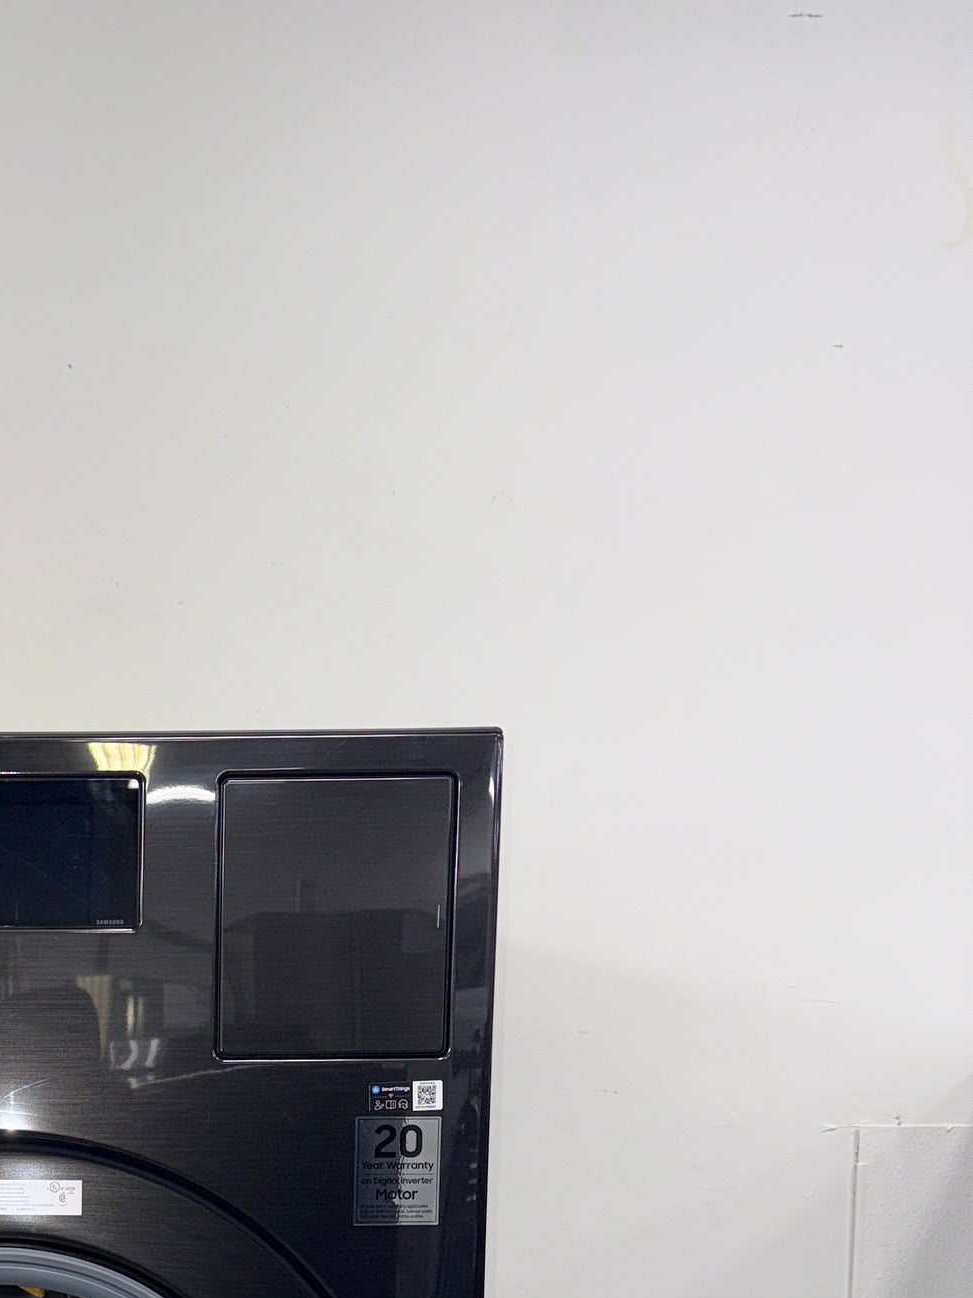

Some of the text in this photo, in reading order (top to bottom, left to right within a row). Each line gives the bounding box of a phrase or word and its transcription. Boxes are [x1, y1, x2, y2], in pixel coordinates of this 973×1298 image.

[381, 1085, 411, 1093] SmartThings
[374, 1124, 423, 1158] 20
[361, 1161, 434, 1172] Year Warranty
[374, 1177, 399, 1186] Digital
[400, 1177, 433, 1185] Inverter
[375, 1188, 419, 1200] Motor
